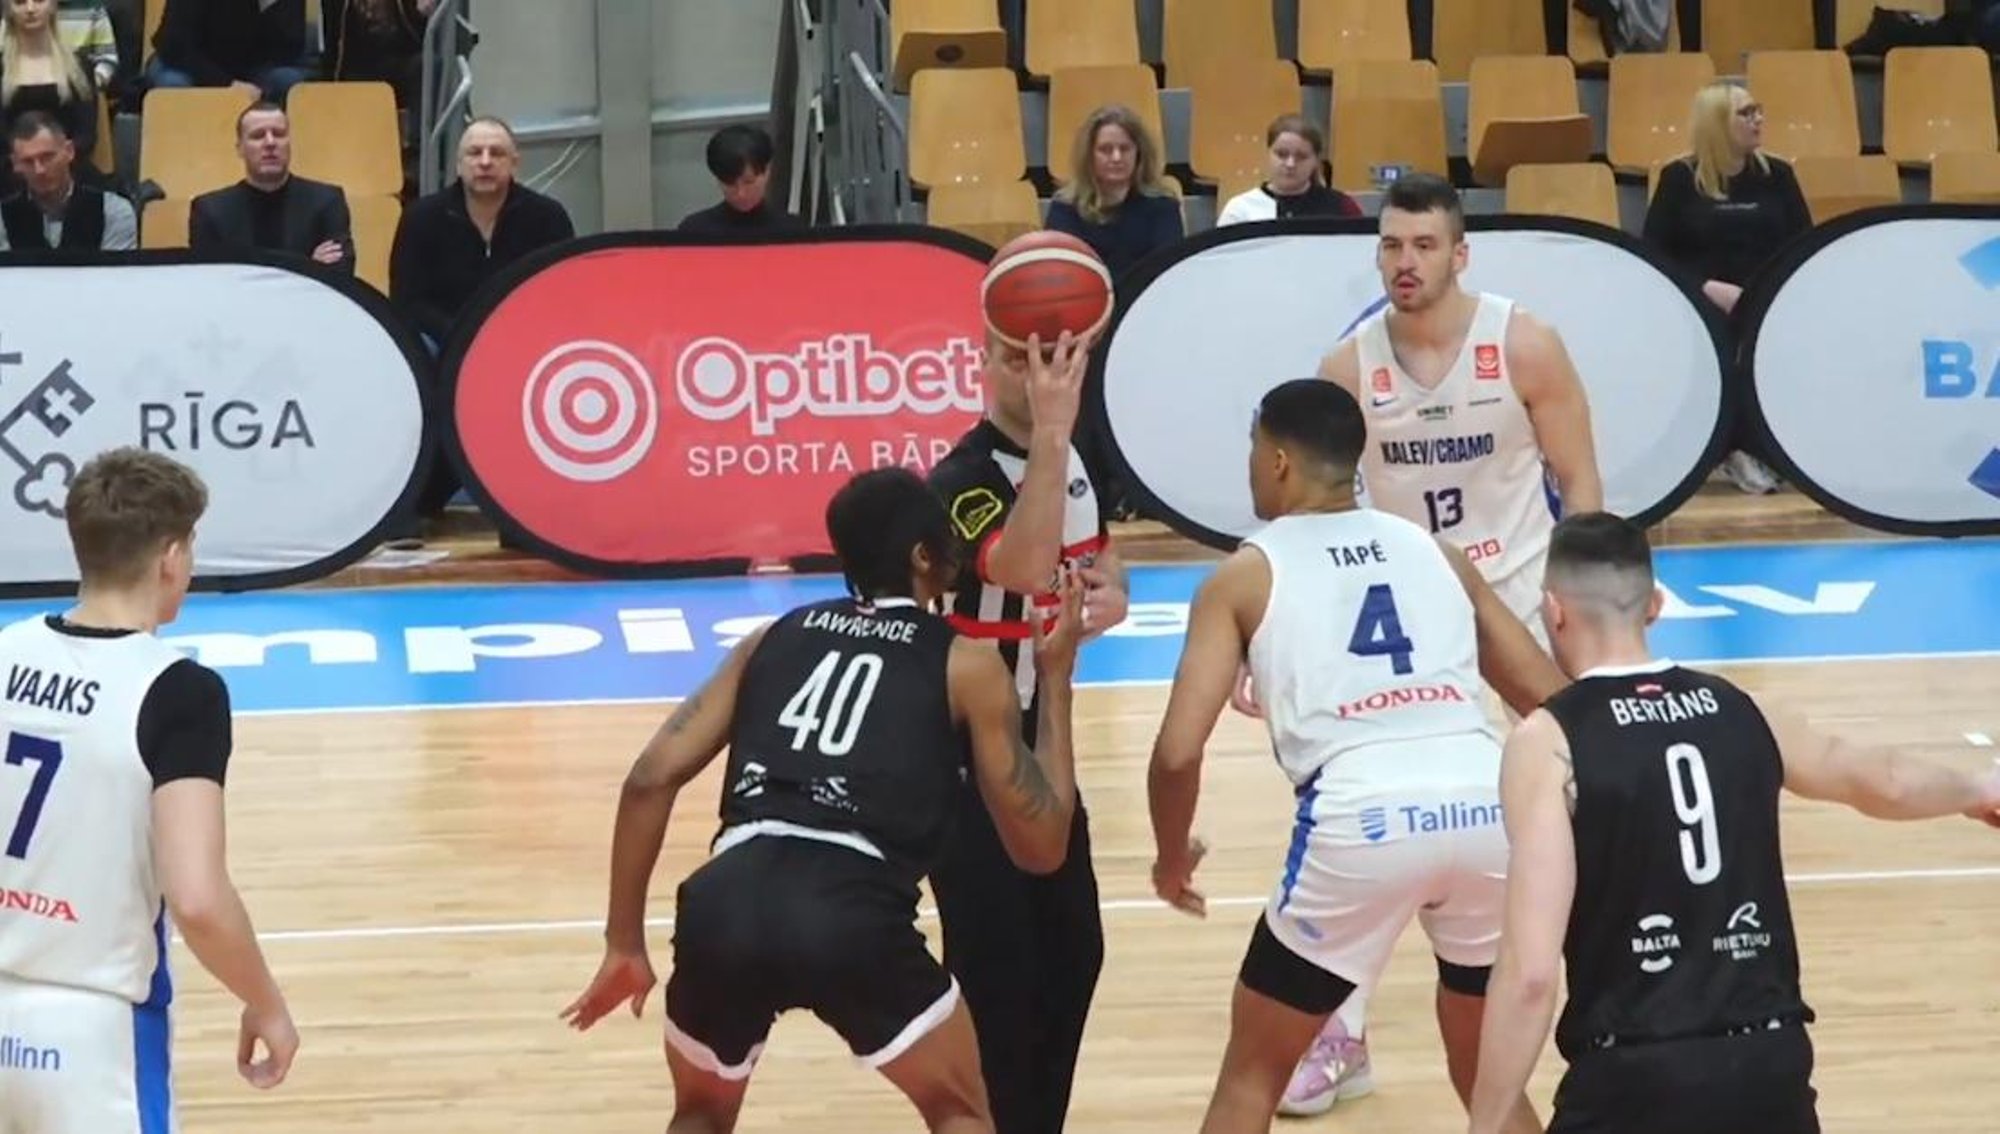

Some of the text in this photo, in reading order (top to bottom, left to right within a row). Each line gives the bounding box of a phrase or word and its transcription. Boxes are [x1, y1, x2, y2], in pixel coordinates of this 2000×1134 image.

[676, 333, 984, 435] Optibet
[1921, 340, 2000, 399] B
[140, 391, 316, 450] RĪGA
[687, 442, 854, 477] SPORTA
[1380, 433, 1494, 465] KALEV/CRAMO
[1424, 487, 1464, 534] 13
[1327, 540, 1388, 568] TAPÉ
[803, 610, 919, 643] LAWRENCE
[1347, 583, 1414, 676] 4
[6, 664, 101, 716] VAAKS
[778, 650, 883, 756] 40
[1339, 685, 1464, 719] HONDA
[1610, 687, 1720, 725] BERTĀNS
[5, 731, 63, 859] 7
[1665, 742, 1722, 885] 9
[1631, 934, 1681, 952] BALTA
